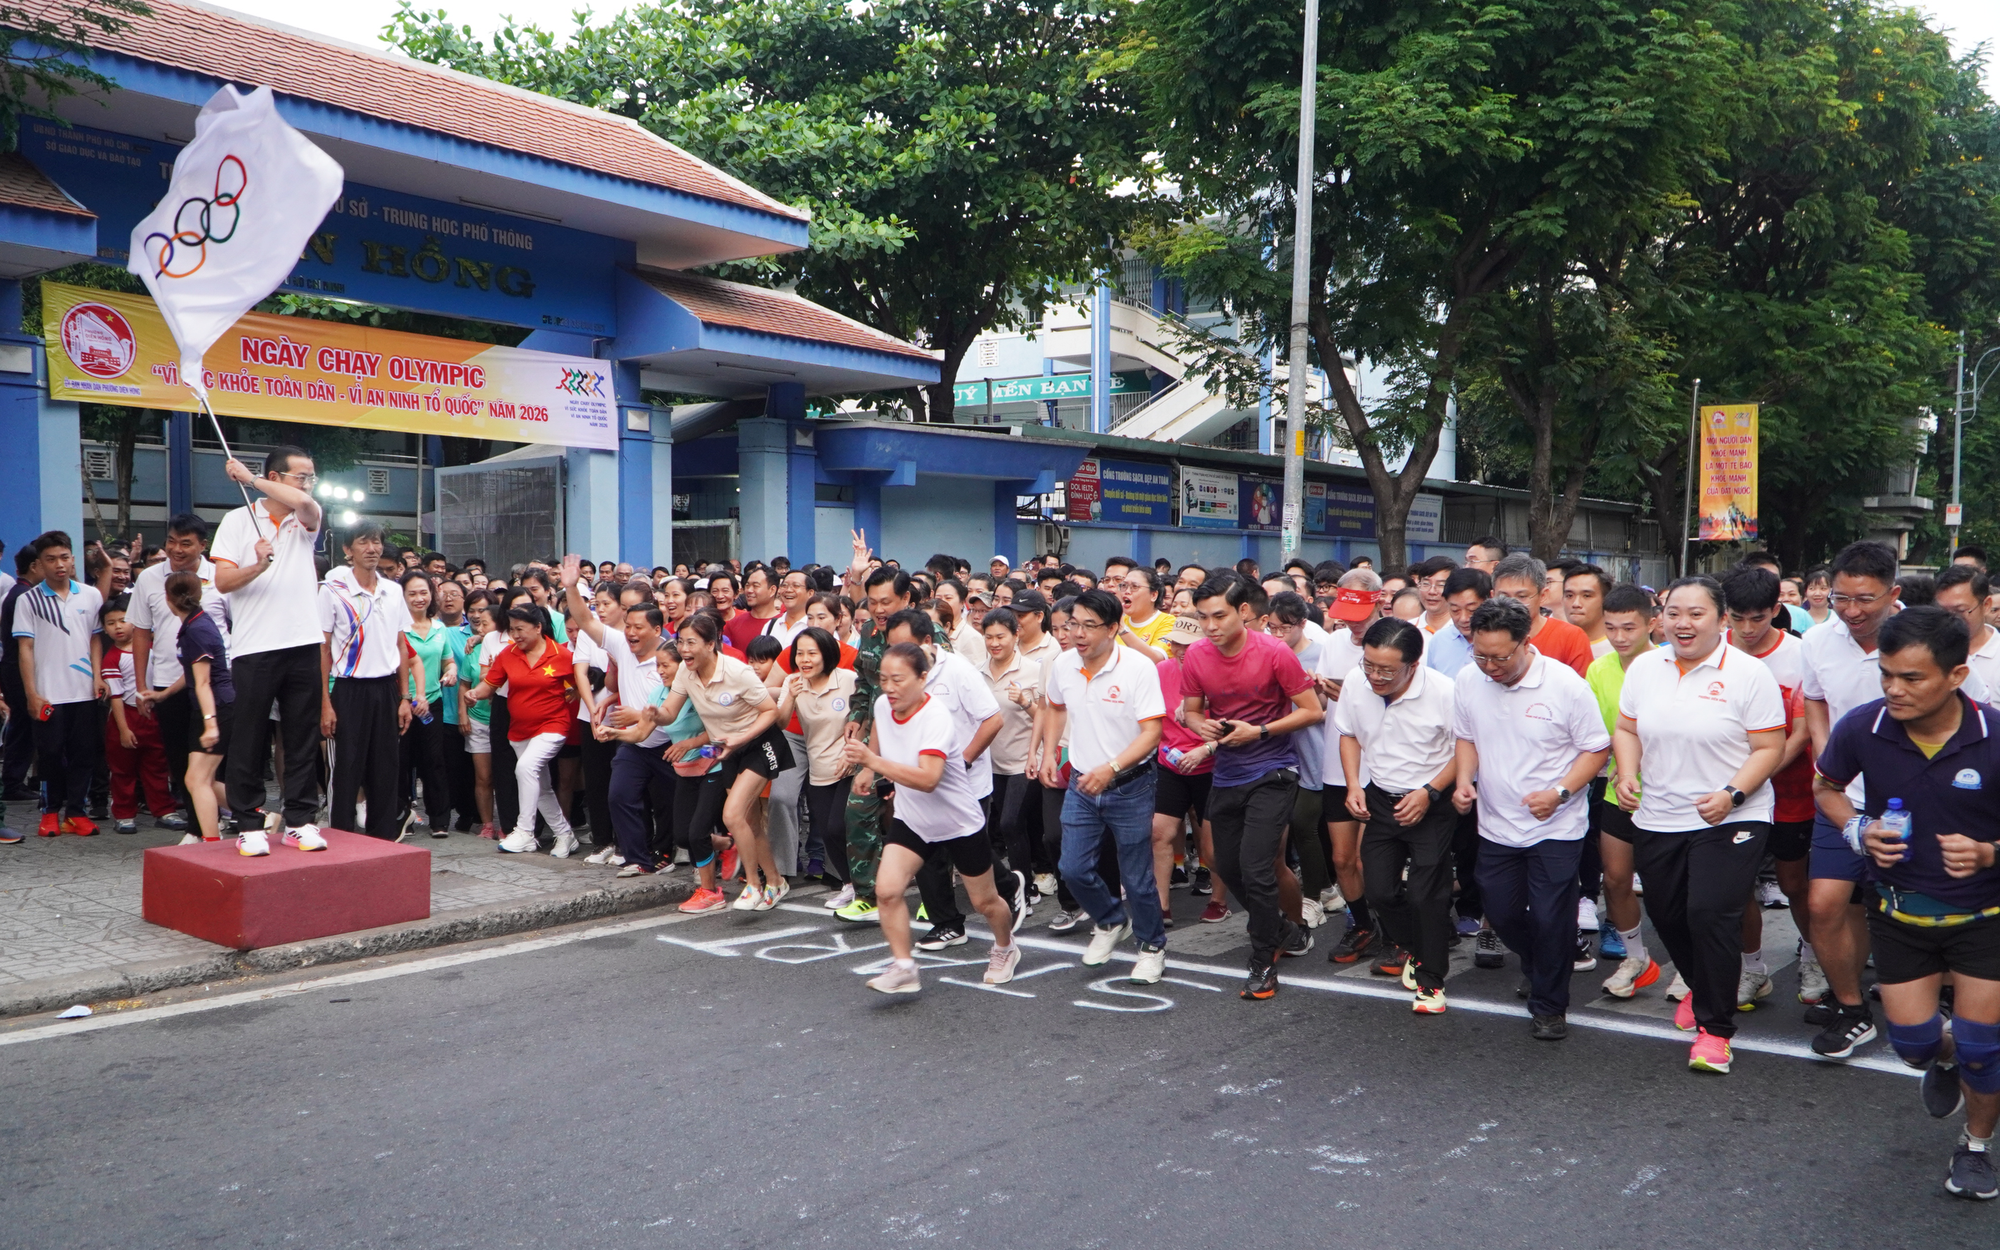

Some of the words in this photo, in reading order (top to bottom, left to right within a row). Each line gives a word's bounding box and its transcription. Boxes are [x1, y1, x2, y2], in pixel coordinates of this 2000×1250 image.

[349, 197, 368, 218] SỞ
[382, 206, 428, 230] TRUNG
[431, 216, 459, 237] HỌC
[491, 228, 533, 251] THÔNG
[361, 235, 536, 299] HỒNG
[241, 336, 310, 369] NGÀY
[317, 347, 382, 381] CHẠY
[388, 356, 486, 389] OLYMPIC
[218, 368, 260, 395] KHỎE
[264, 375, 303, 400] TOÀN
[306, 379, 336, 403] DÂN
[348, 383, 363, 405] VÌ
[366, 389, 385, 408] AN
[388, 391, 420, 411] NINH
[423, 388, 441, 413] TỔ
[488, 400, 516, 420] NĂM
[519, 405, 549, 423] 2026
[954, 385, 978, 401] UÝ
[985, 381, 1032, 398] MẾN
[1040, 379, 1087, 396] BẠN
[1110, 373, 1126, 389] È
[1719, 434, 1738, 444] NGƯỜI
[1070, 483, 1081, 491] DOL
[1081, 484, 1094, 492] IELTS
[1070, 490, 1083, 499] ĐÌNH
[1175, 620, 1200, 633] ORT
[762, 741, 778, 770] SPORTS
